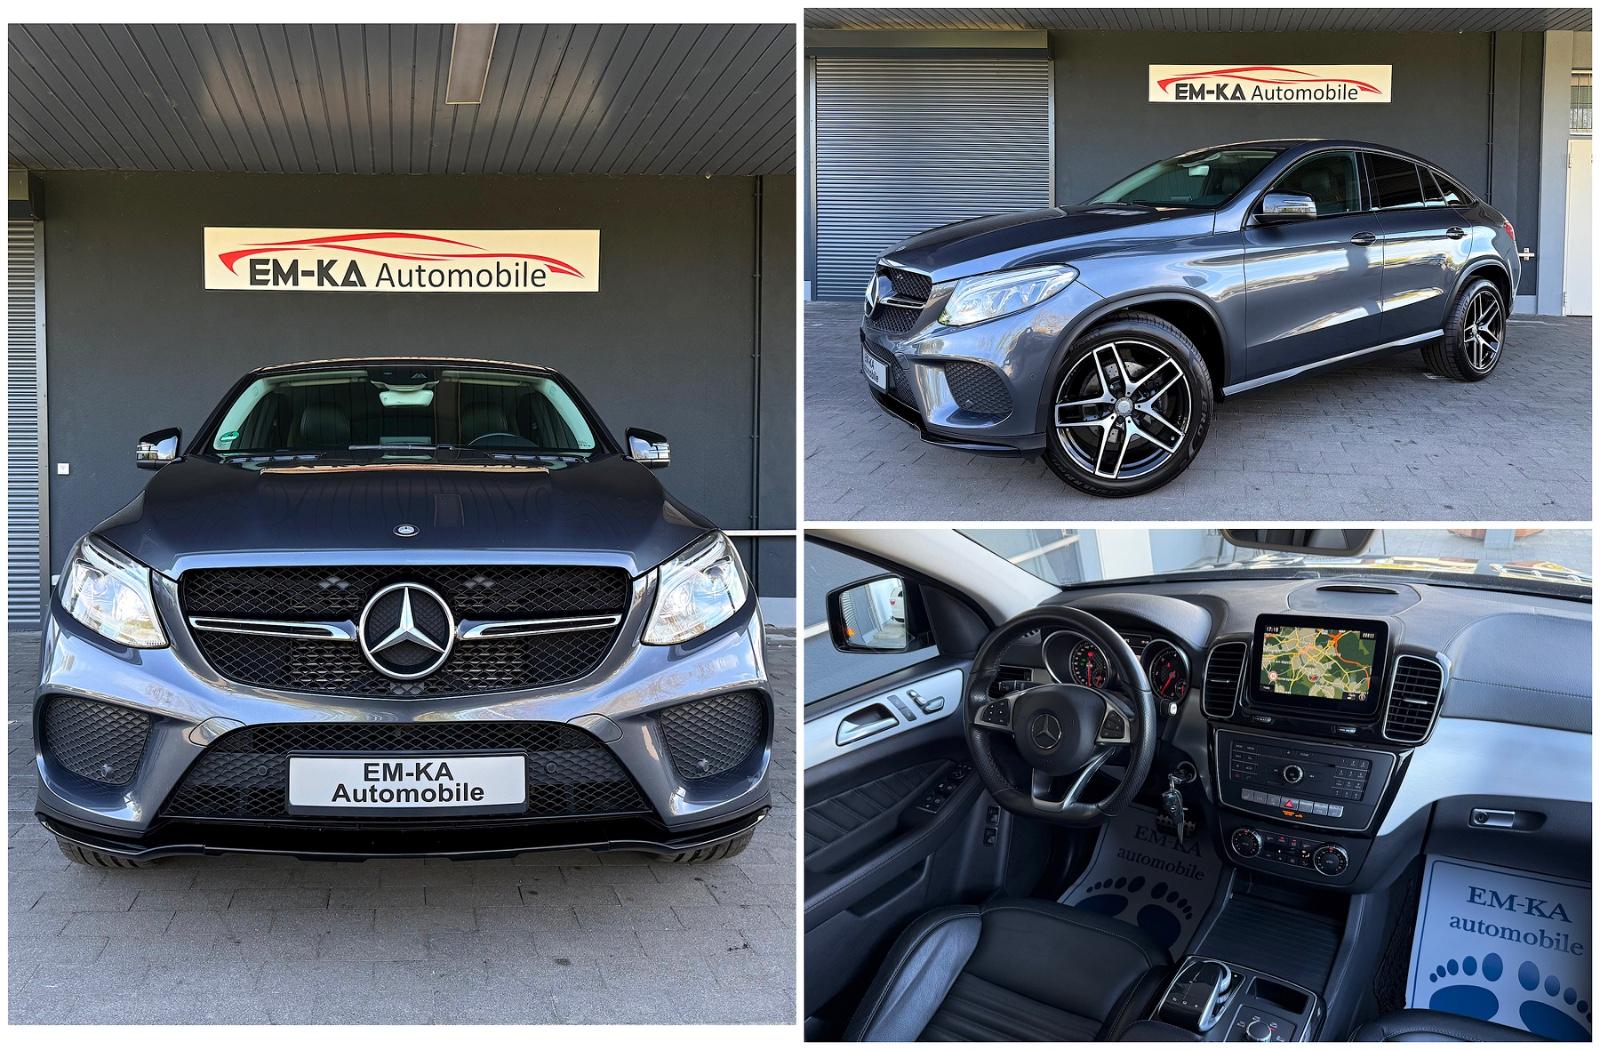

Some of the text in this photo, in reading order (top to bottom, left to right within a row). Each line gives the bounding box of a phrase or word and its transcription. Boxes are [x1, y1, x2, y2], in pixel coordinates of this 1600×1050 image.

[1175, 83, 1358, 101] EM-KA Automobile
[249, 258, 547, 288] EM-KA Automobile
[363, 762, 454, 782] EM-KA
[331, 783, 485, 803] Automobile
[1135, 825, 1202, 858] EM-KA
[1116, 847, 1205, 880] automobile
[1466, 885, 1573, 924] EM-KA
[1449, 915, 1585, 956] automobile
